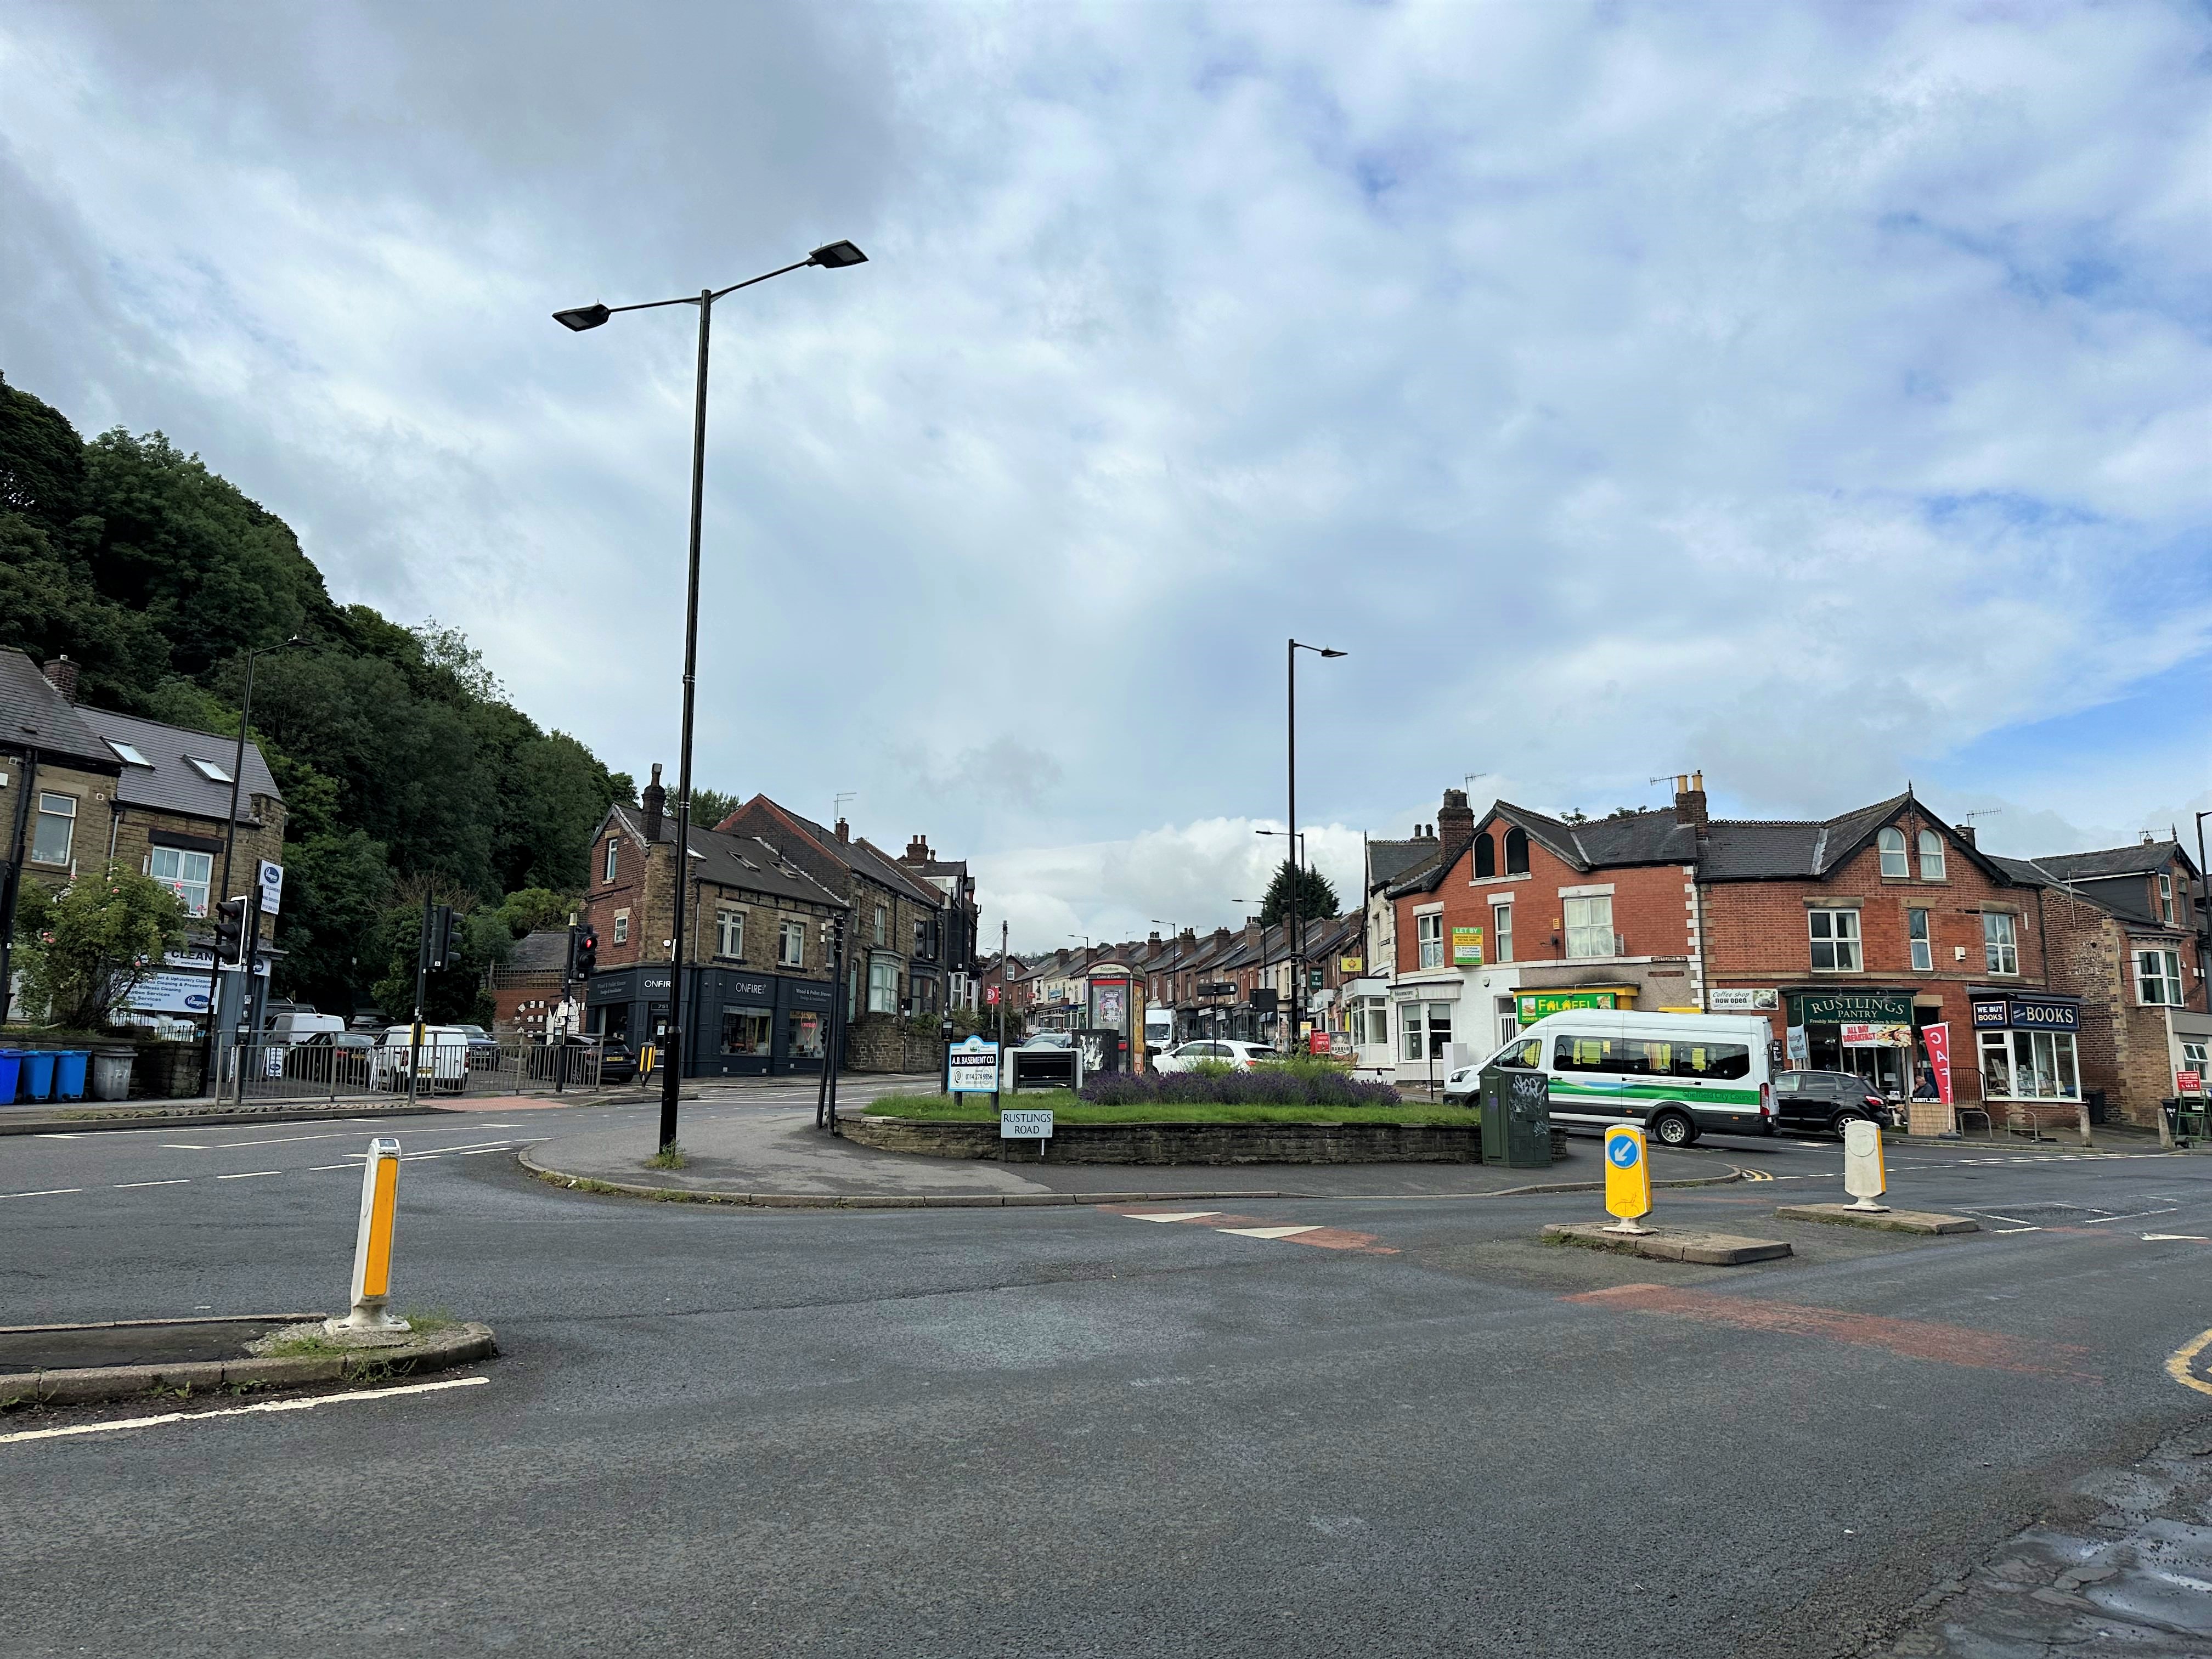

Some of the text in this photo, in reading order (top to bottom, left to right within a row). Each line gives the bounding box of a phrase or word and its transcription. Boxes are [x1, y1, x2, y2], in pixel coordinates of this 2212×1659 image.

[171, 950, 213, 961] CLEAN
[736, 982, 762, 994] ONFIRE
[1810, 998, 1905, 1014] RUSTLINGS
[2026, 1006, 2073, 1024] BOOKS
[1842, 1032, 1876, 1042] BREAKFAST
[962, 1056, 986, 1064] BASEMENT
[986, 1056, 995, 1064] CO.
[1716, 1092, 1728, 1101] City
[1731, 1093, 1755, 1101] Council
[1003, 1114, 1051, 1122] RUSTLINGS
[1014, 1125, 1040, 1134] ROAD
